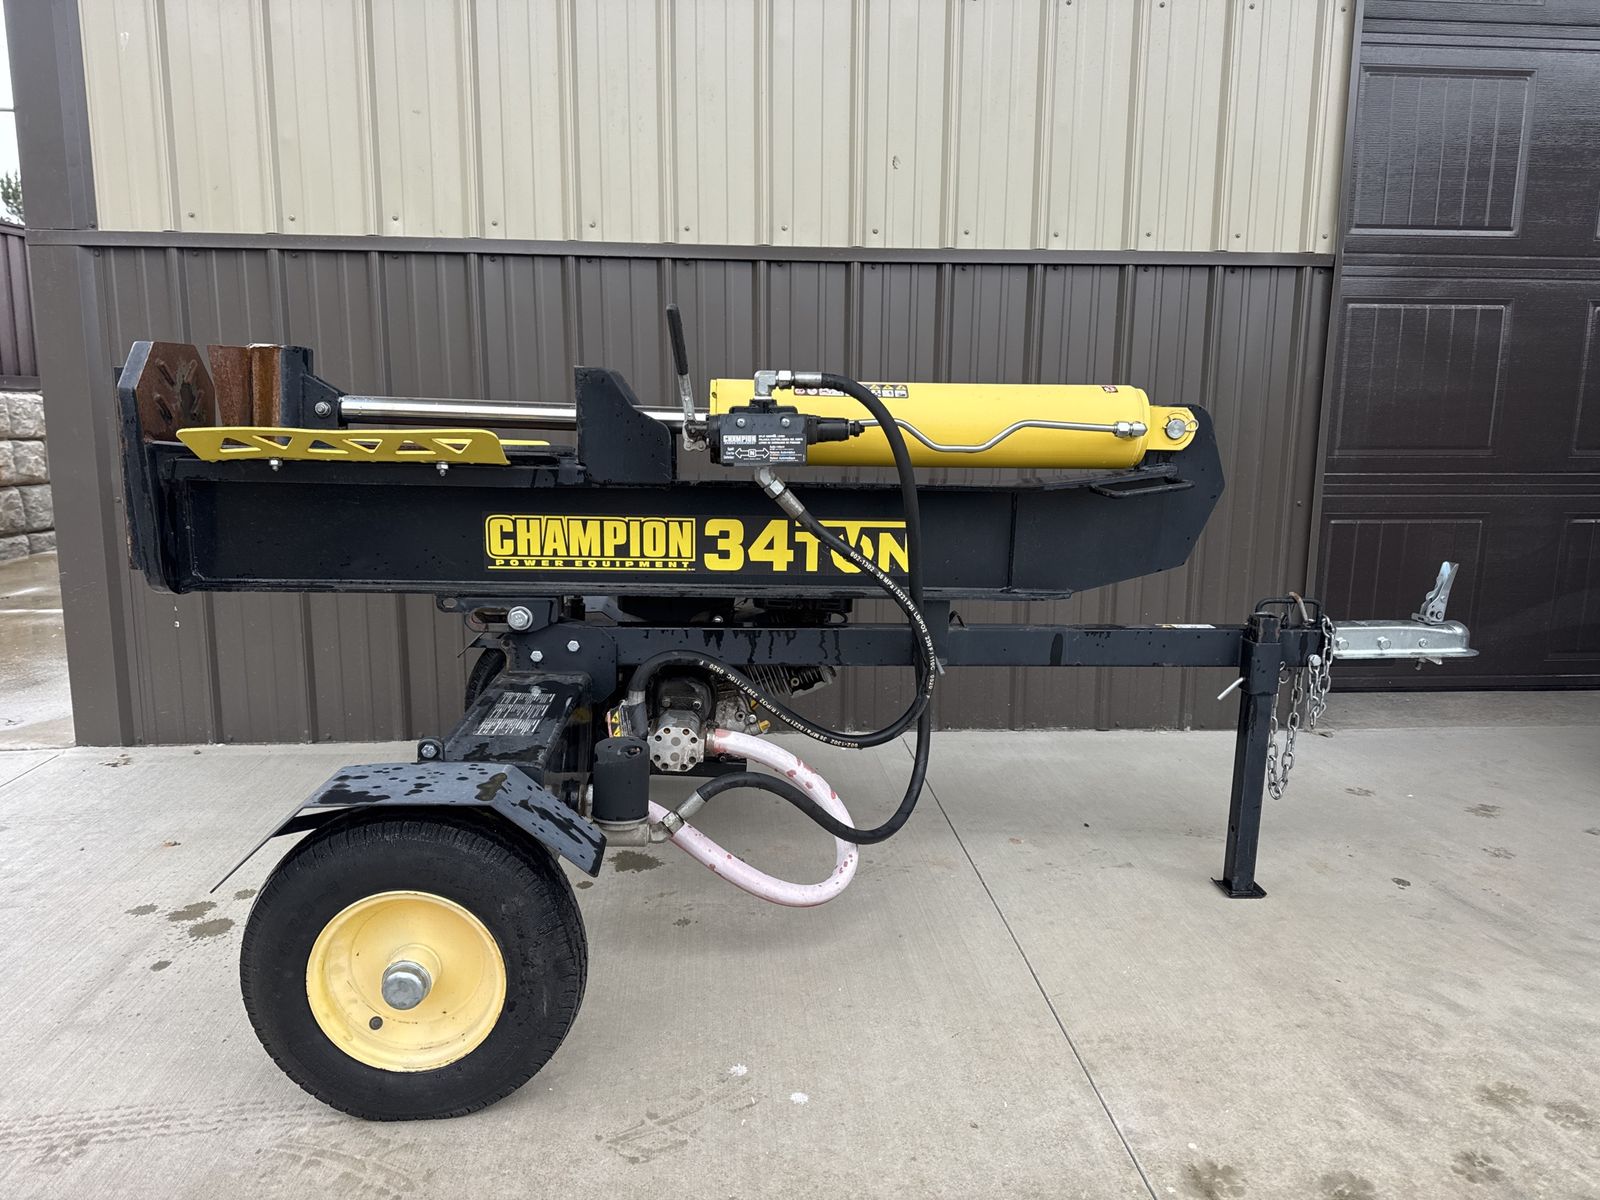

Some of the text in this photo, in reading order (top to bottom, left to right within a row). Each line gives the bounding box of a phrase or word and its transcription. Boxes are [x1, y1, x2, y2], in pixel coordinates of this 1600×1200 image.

[489, 518, 692, 558] CHAMPION
[896, 590, 908, 602] 5221
[906, 601, 914, 611] PSI
